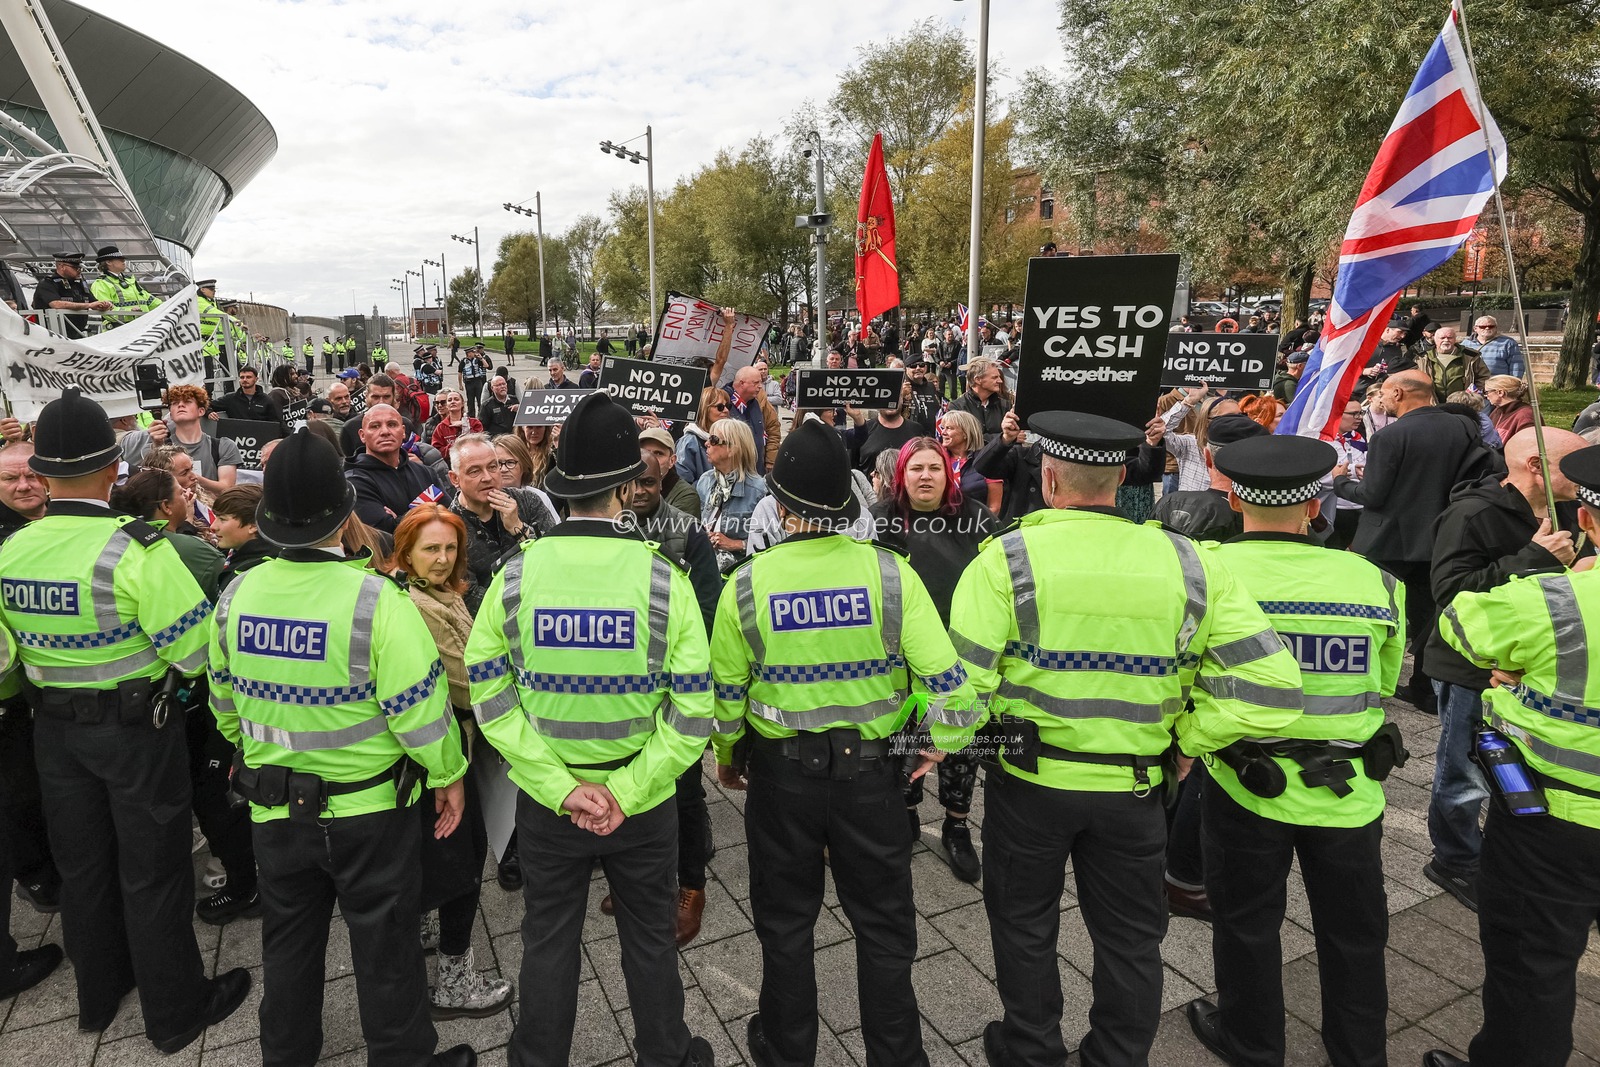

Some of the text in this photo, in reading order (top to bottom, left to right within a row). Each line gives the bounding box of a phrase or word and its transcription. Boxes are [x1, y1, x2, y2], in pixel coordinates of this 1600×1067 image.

[662, 303, 688, 341] END
[1032, 304, 1163, 329] YES TO
[732, 317, 762, 354] NOW
[1043, 335, 1144, 358] CASH
[1178, 341, 1246, 356] NO TO
[1040, 366, 1137, 385] #together
[1163, 357, 1264, 373] IGITAL ID
[628, 368, 682, 388] NO TO
[826, 376, 879, 386] NO TO
[1184, 374, 1227, 382] #together
[543, 394, 566, 404] NO
[608, 383, 693, 406] DIGITAL ID
[806, 388, 892, 398] DIGITAL ID
[525, 405, 576, 415] DIGITA
[235, 436, 257, 447] NO
[3, 582, 75, 611] POLICE
[774, 592, 868, 626] POLICE
[240, 620, 322, 656] POLICE
[537, 614, 631, 644] POLICE
[1279, 634, 1366, 672] LICE
